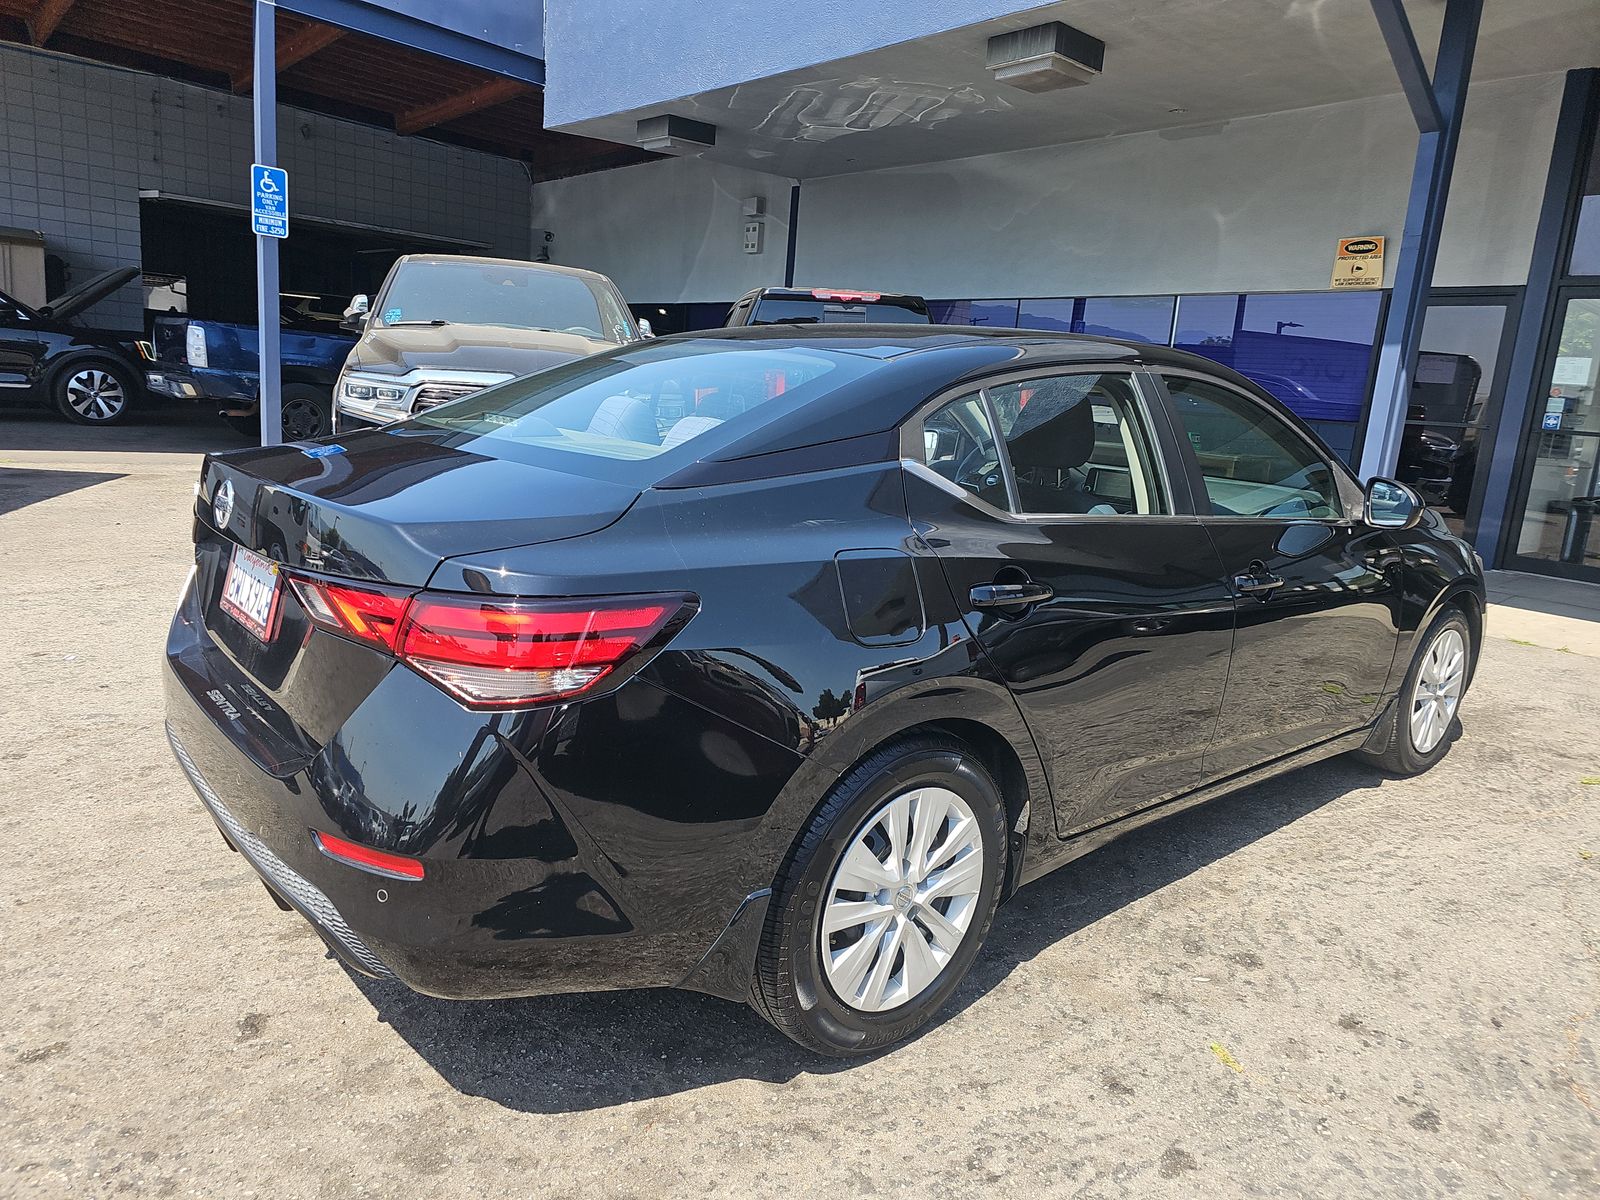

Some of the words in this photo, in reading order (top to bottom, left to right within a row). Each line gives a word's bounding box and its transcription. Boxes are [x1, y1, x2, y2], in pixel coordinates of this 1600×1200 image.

[256, 191, 283, 201] PARKING
[255, 208, 286, 217] ACCESSIBLE
[258, 217, 283, 227] MINIMUM
[256, 224, 269, 232] FINE
[1348, 243, 1376, 251] WARNING
[206, 689, 242, 721] SENTRA
